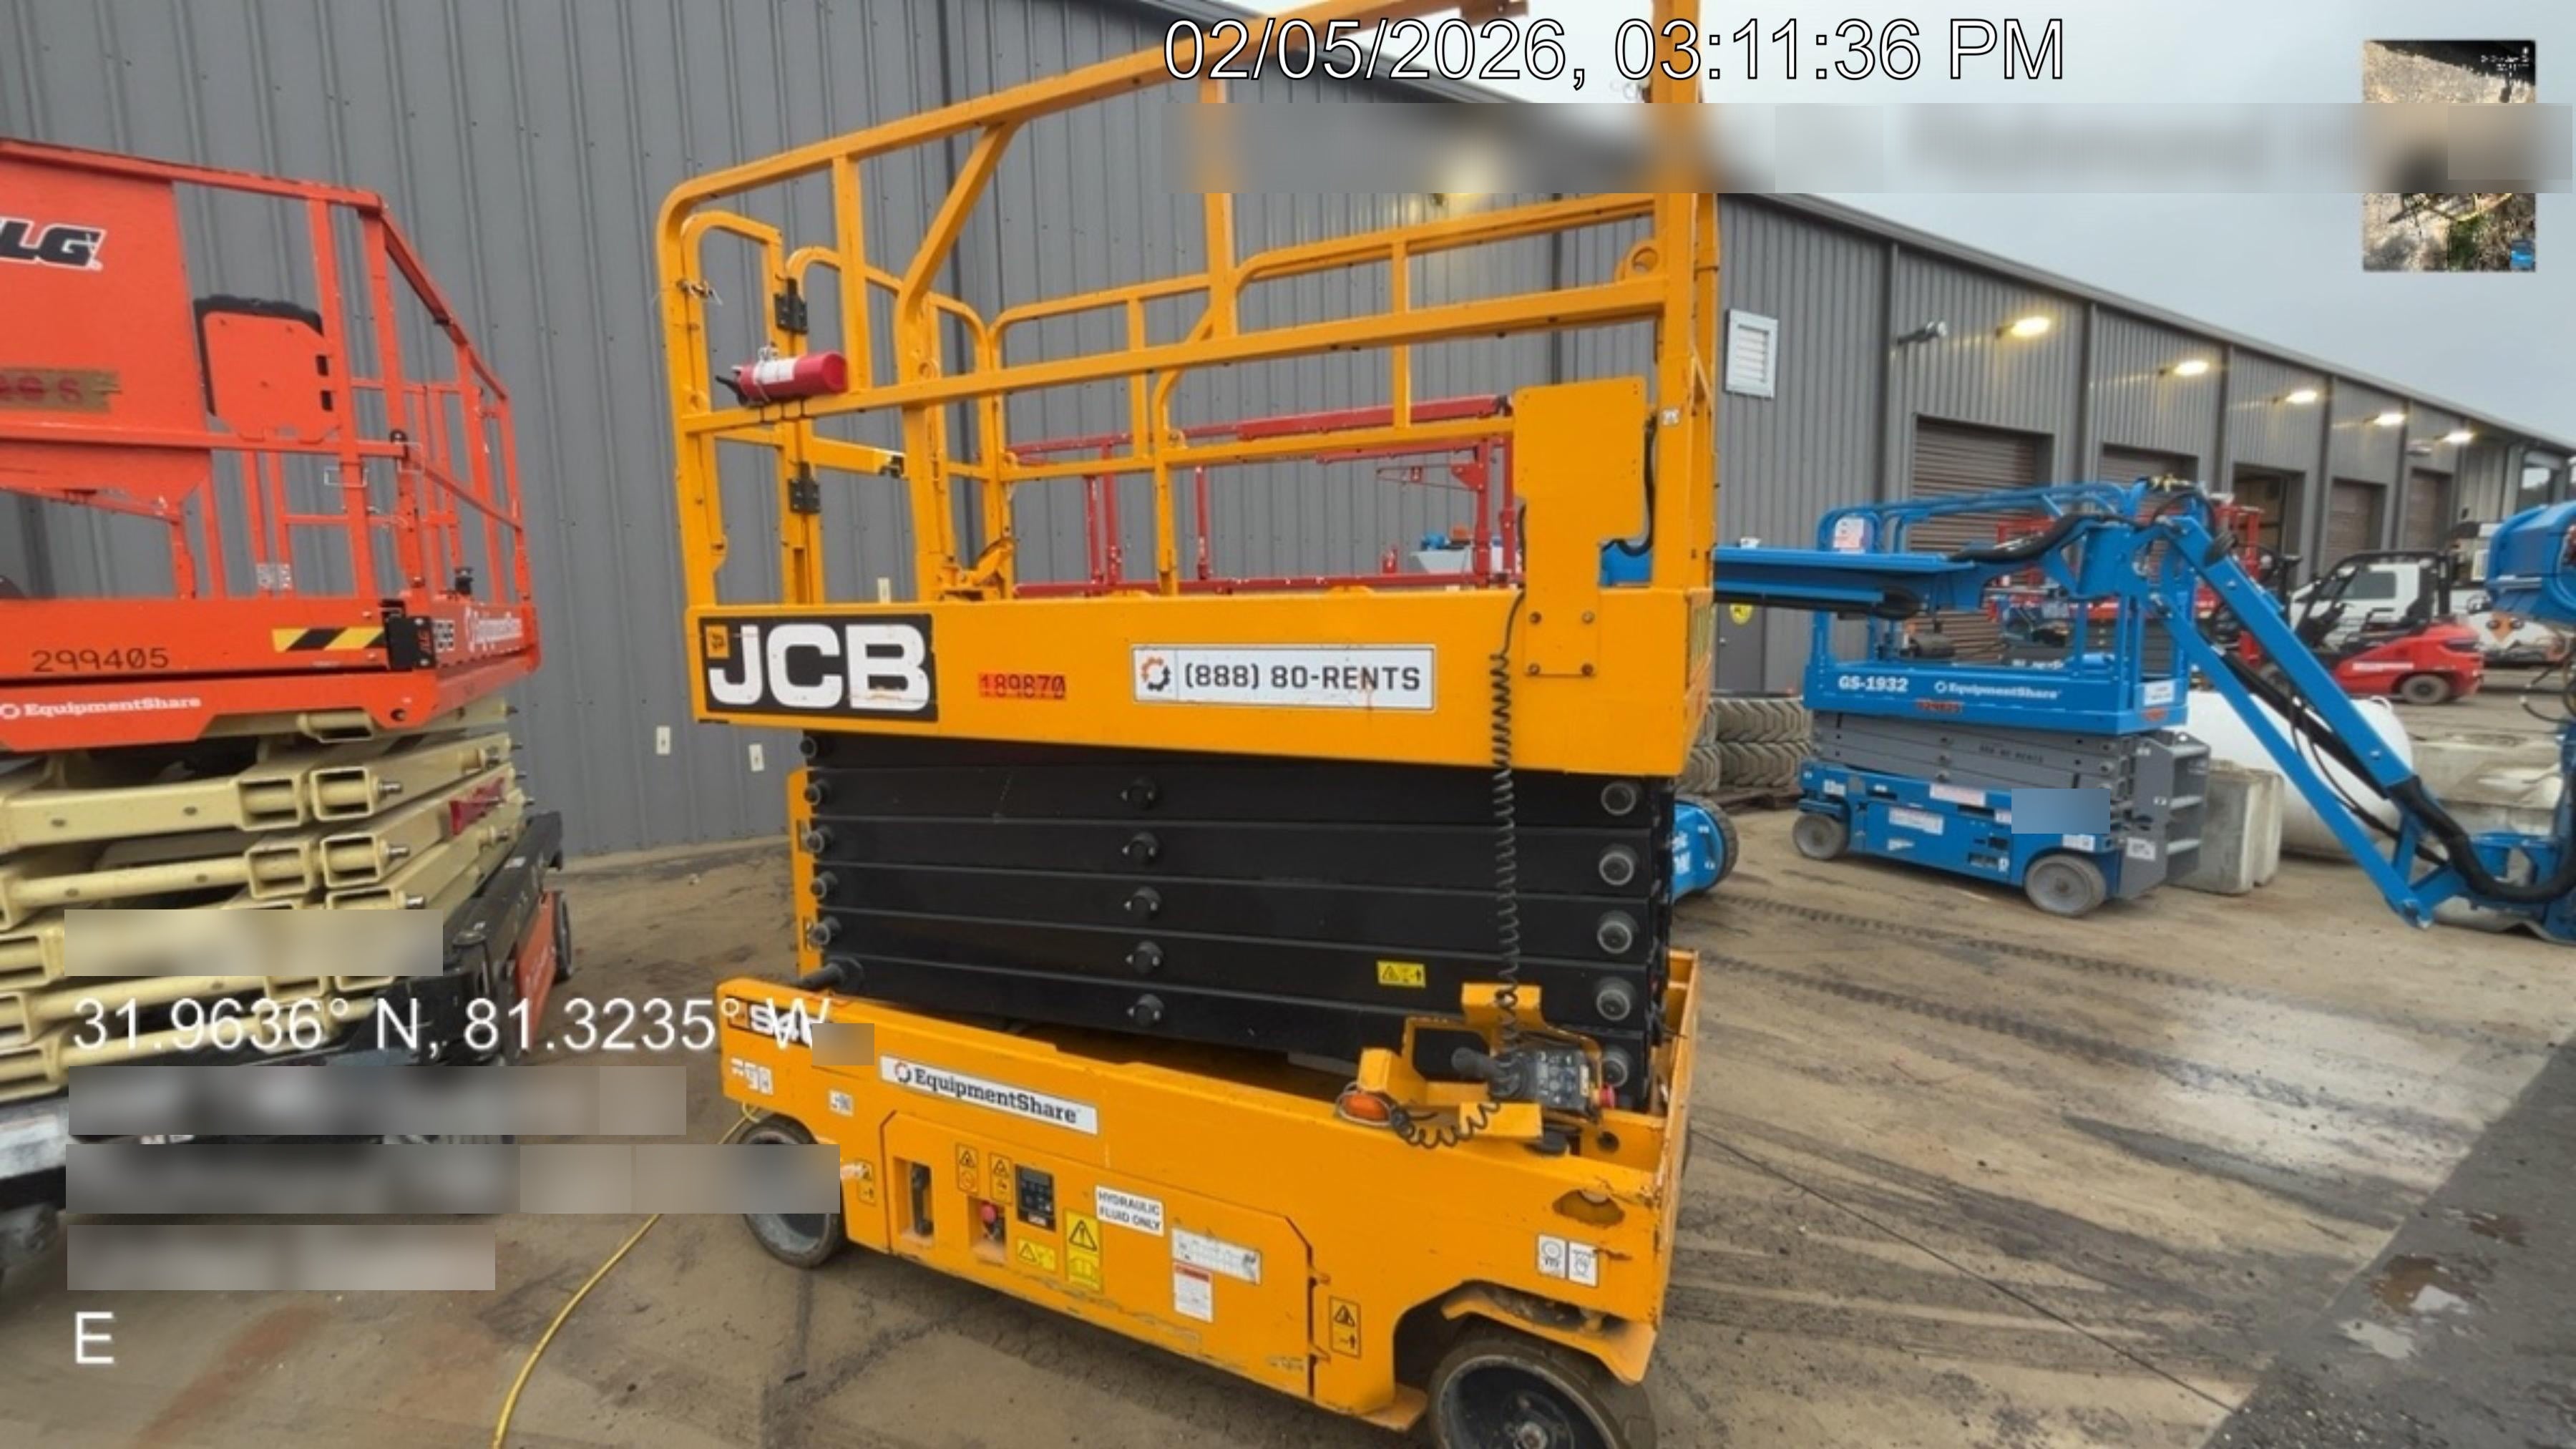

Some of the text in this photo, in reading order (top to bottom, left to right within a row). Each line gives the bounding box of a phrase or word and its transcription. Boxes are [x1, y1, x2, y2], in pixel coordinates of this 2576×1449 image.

[31, 648, 170, 673] 299405
[708, 624, 930, 711] JCB
[1184, 663, 1420, 691] (888) 80-RENTS
[1838, 675, 1909, 693] GS-1932
[1948, 682, 2058, 700] EquipmentShare
[24, 697, 203, 718] EquipmentShare
[914, 1068, 1077, 1123] EquipmentShare
[1098, 1190, 1161, 1216] HYDRAULIC
[1098, 1206, 1161, 1231] FLUID ONLY
